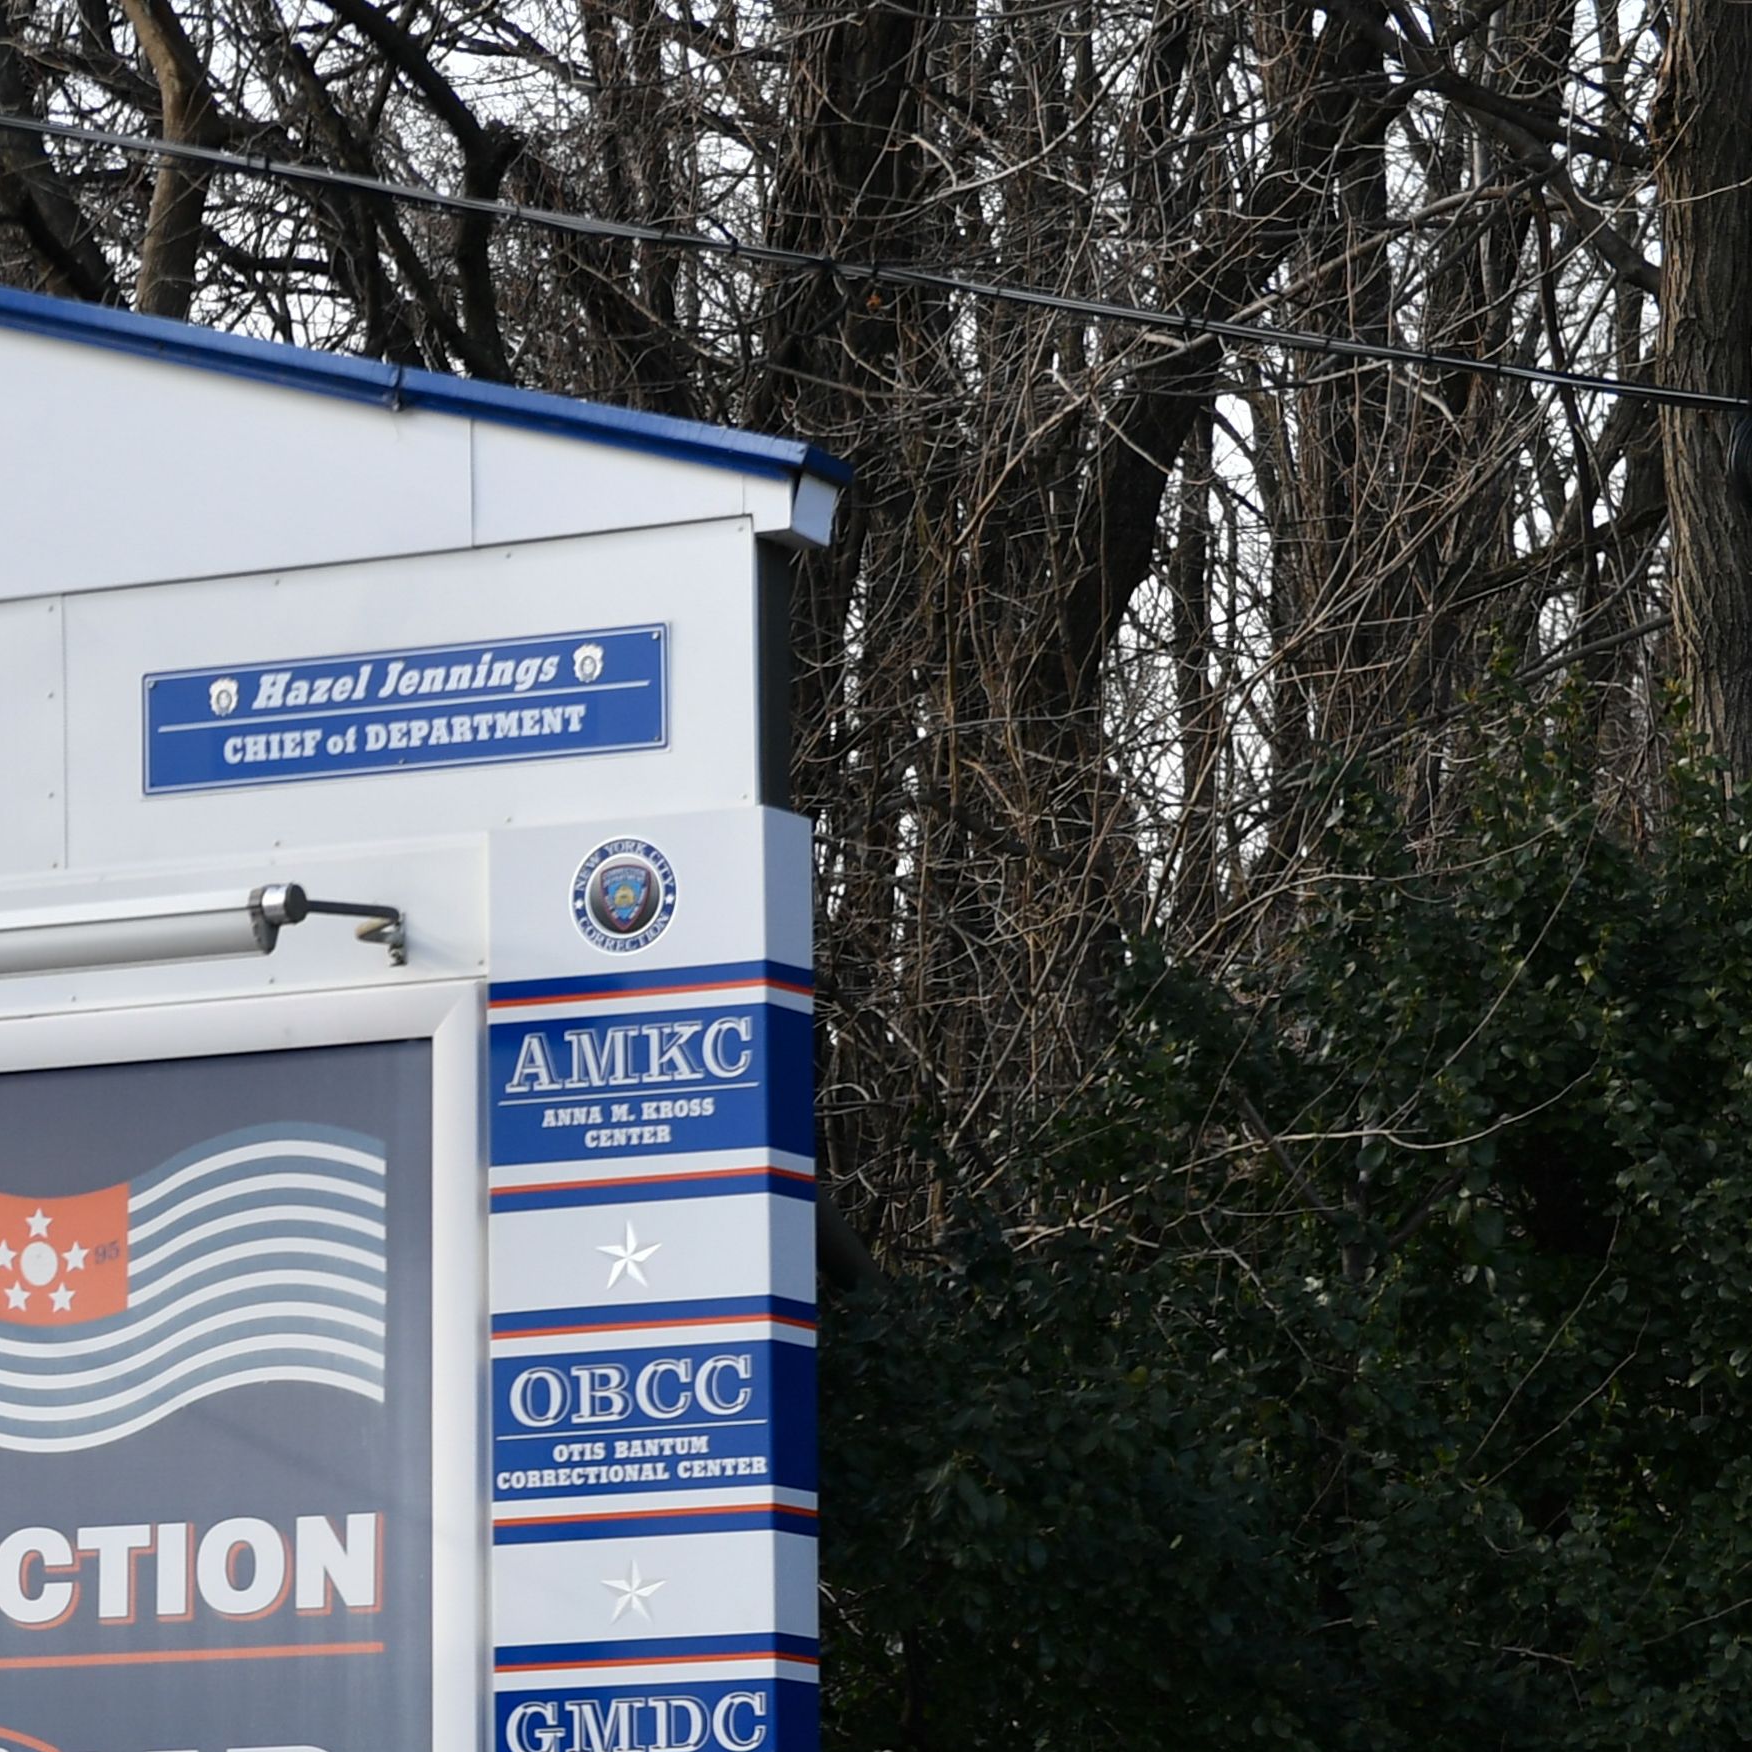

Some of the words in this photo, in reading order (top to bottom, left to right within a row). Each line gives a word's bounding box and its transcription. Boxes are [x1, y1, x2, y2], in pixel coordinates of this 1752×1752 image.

[251, 664, 373, 710] Hazel
[378, 652, 560, 700] Jennings
[222, 728, 323, 764] CHIEF
[326, 726, 356, 755] of
[365, 704, 586, 752] DEPARTMENT
[575, 852, 600, 891] NEW
[604, 840, 647, 855] YORK
[650, 850, 675, 887] CITY
[505, 1016, 753, 1094] AMKC
[541, 1105, 603, 1128] ANNA
[611, 1103, 636, 1123] M.
[640, 1097, 715, 1120] KROSS
[584, 1124, 672, 1149] CENTER
[94, 1240, 120, 1264] 95
[508, 1354, 752, 1428] OBCC
[552, 1442, 606, 1463] OTIS
[613, 1435, 710, 1459] BANTUM
[496, 1463, 670, 1491] CORRECTIONAL
[677, 1456, 768, 1479] CENTER
